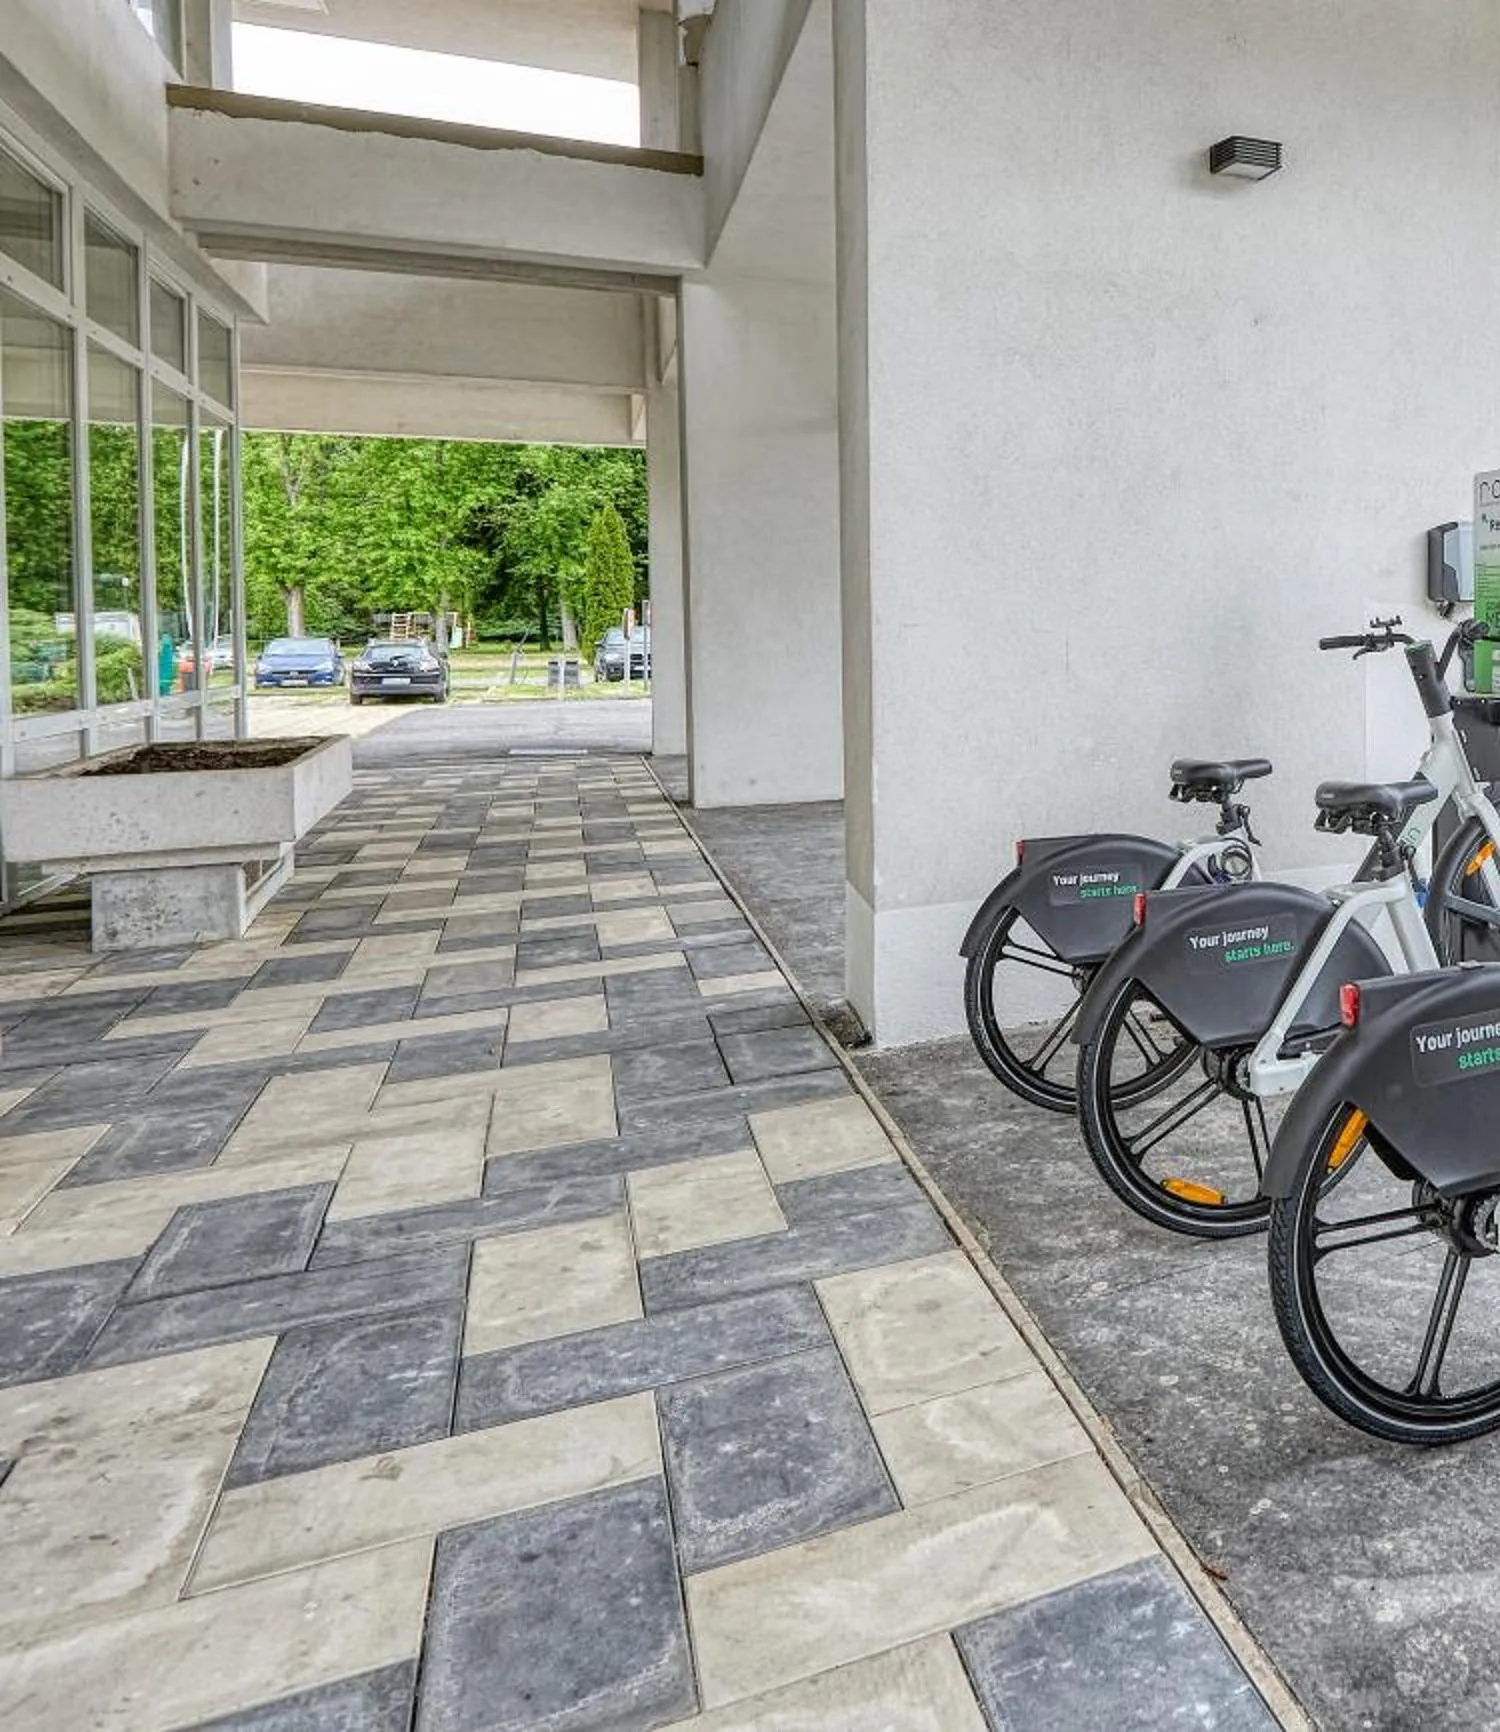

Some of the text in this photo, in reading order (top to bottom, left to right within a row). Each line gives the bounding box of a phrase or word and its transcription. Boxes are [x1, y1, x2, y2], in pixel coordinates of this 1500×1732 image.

[1052, 872, 1119, 886] Your journey
[1189, 924, 1269, 950] Your journey
[1224, 947, 1261, 963] starts
[1416, 1032, 1453, 1053] Your
